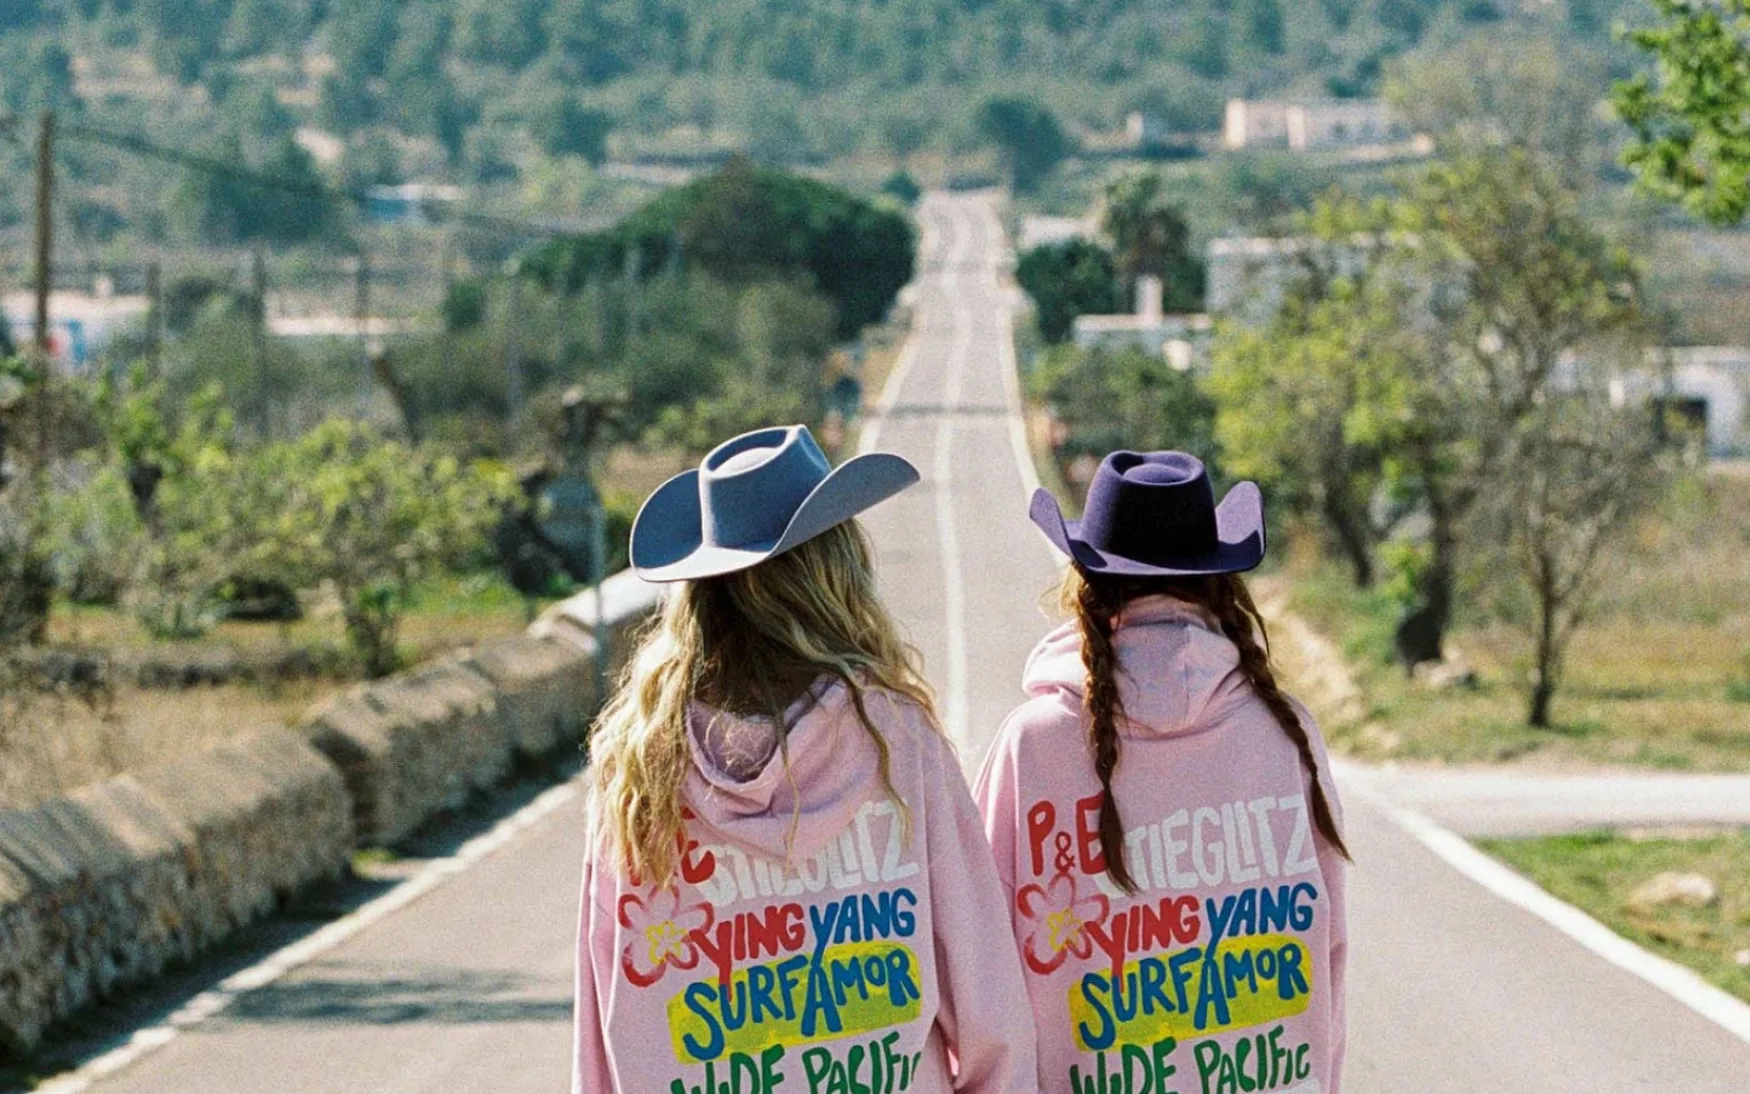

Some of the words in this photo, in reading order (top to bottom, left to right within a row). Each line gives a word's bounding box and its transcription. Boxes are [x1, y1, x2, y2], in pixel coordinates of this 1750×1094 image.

[1092, 793, 1319, 900] TIEGLITZ
[690, 903, 806, 1003] YING
[808, 888, 918, 968] YANG
[1084, 895, 1201, 994] YING
[1205, 883, 1318, 958] YANG
[682, 949, 921, 1061] SURFAMOR
[1079, 943, 1310, 1050] SURFAMOR
